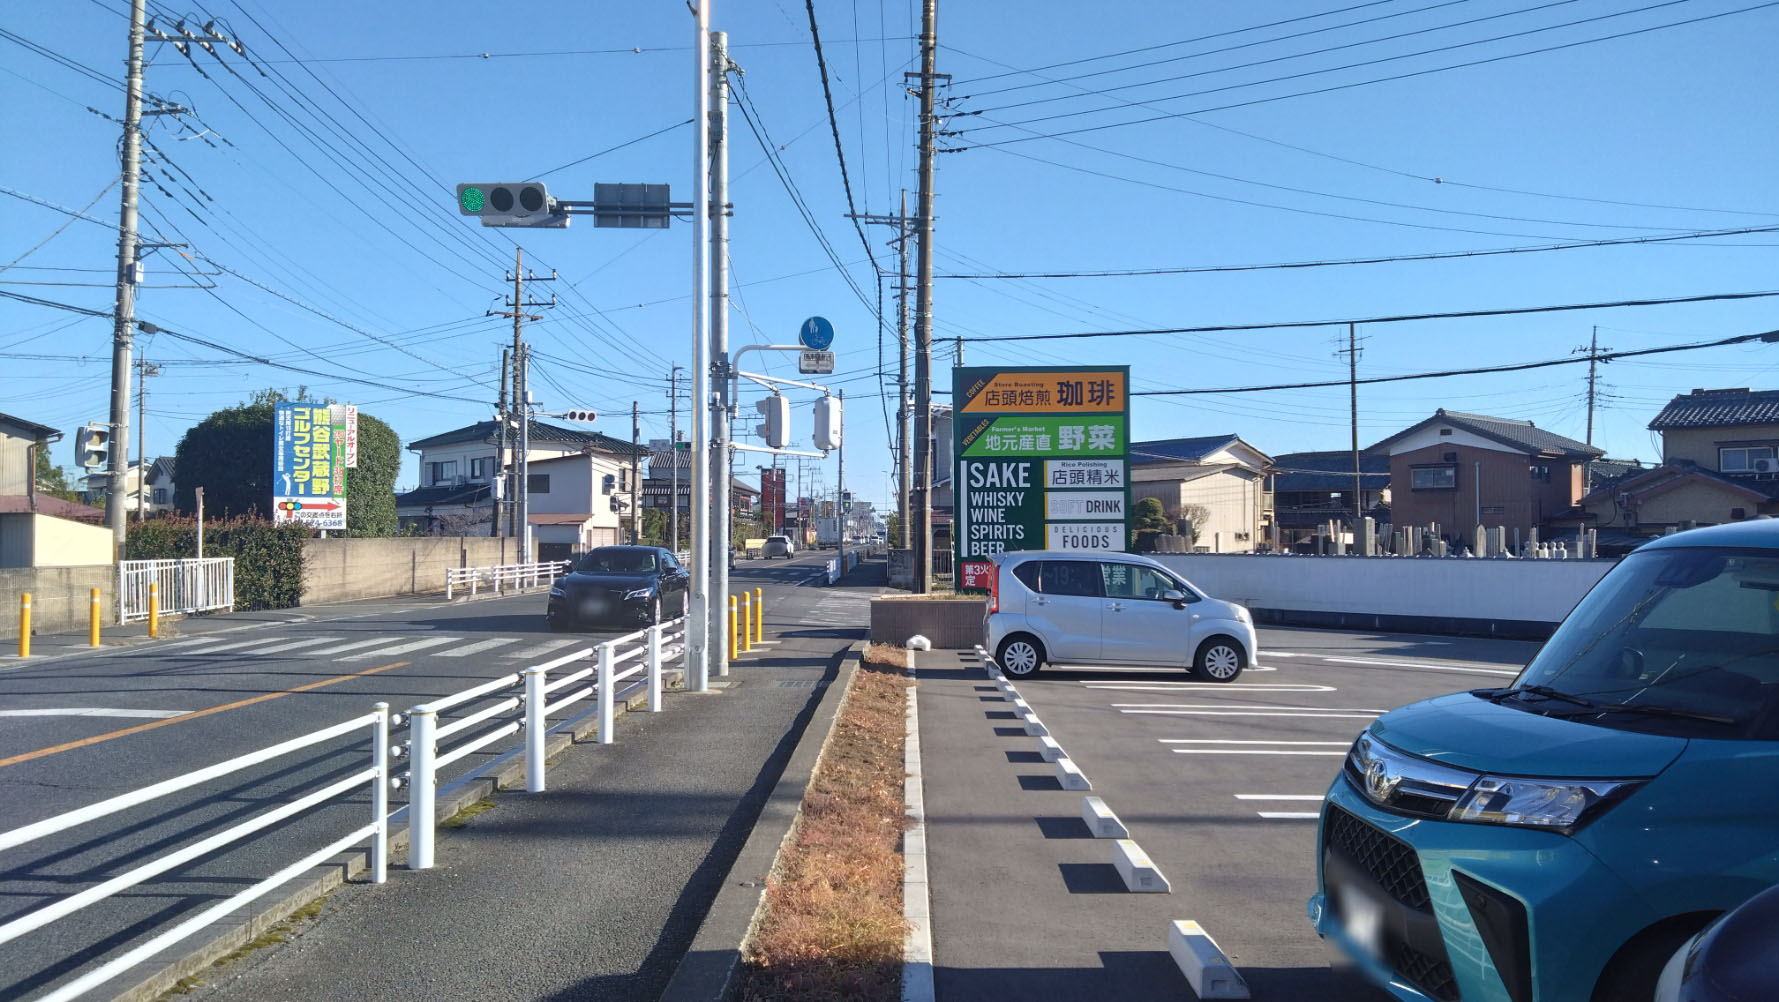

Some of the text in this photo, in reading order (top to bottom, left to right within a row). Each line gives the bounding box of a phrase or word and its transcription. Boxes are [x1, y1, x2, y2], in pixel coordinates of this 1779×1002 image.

[985, 379, 1115, 407] 店頭焙煎 珈琲
[346, 407, 356, 466] リニューアルオープン
[961, 418, 990, 447] VEGETABLES
[985, 424, 1115, 451] 地元産直 野菜
[293, 407, 311, 495] ゴルフセンター
[970, 462, 1031, 488] SAKE
[1052, 469, 1120, 485] 店頭精米
[970, 491, 1025, 507] WHISKY
[1050, 499, 1121, 514] SOFT DRINK
[970, 508, 1005, 523] WINE
[971, 524, 1025, 540] SPIRITS
[971, 541, 1005, 556] BEER
[1063, 535, 1110, 549] FOODS
[965, 575, 976, 587] 定
